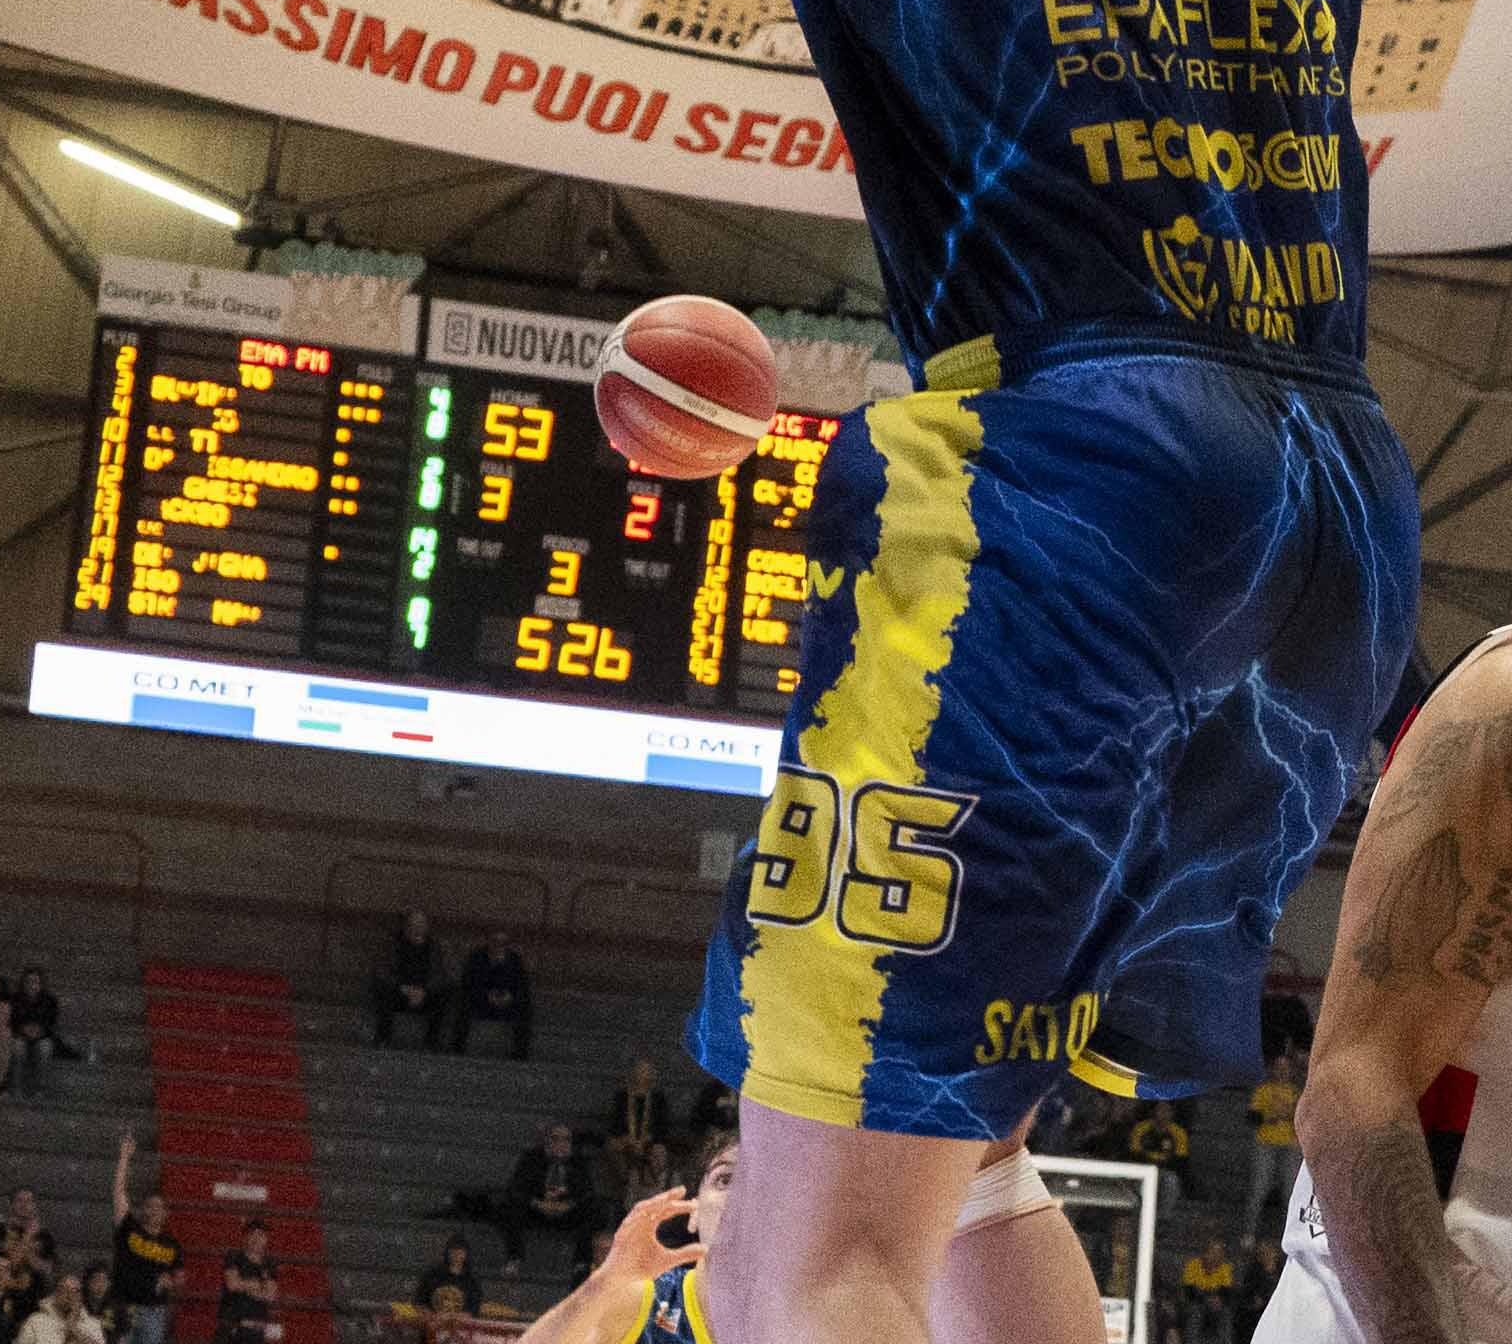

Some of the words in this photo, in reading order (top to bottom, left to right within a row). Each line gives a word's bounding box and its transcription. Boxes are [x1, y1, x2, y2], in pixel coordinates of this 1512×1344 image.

[488, 49, 669, 142] PUOI
[1056, 51, 1349, 97] POLYRETHANES
[478, 316, 607, 369] NUOVAC
[481, 402, 556, 462] 53
[478, 475, 514, 522] 3
[623, 494, 662, 541] 2
[546, 550, 582, 597] 3
[746, 763, 985, 956] 95
